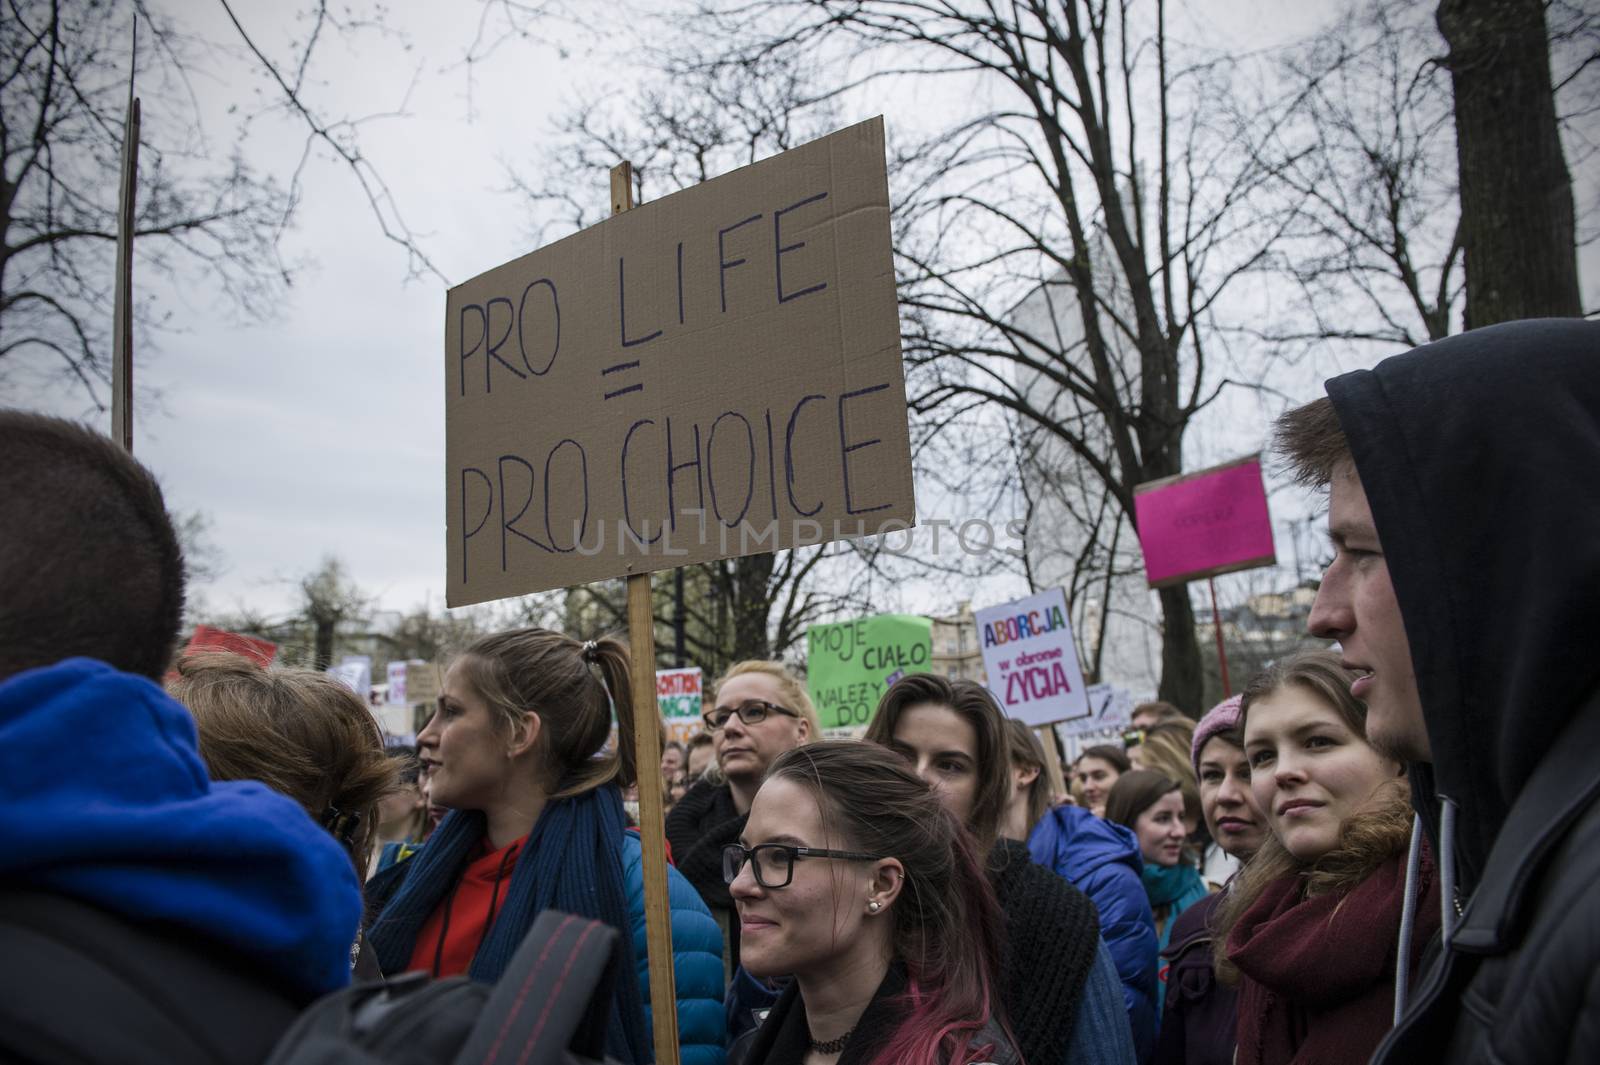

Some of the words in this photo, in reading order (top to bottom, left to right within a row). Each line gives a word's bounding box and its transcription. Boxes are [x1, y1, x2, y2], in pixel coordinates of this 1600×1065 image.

[461, 278, 561, 396] PRO
[620, 192, 829, 347] LIFE
[462, 438, 589, 585] PRO
[620, 383, 894, 545] CHOICE
[811, 620, 867, 662] MOJE
[984, 605, 1066, 648] ABORCJA
[863, 642, 927, 670] CIAŁO
[1015, 647, 1063, 667] obronie
[1001, 661, 1071, 705] ŻYCIA
[837, 702, 870, 726] DO
